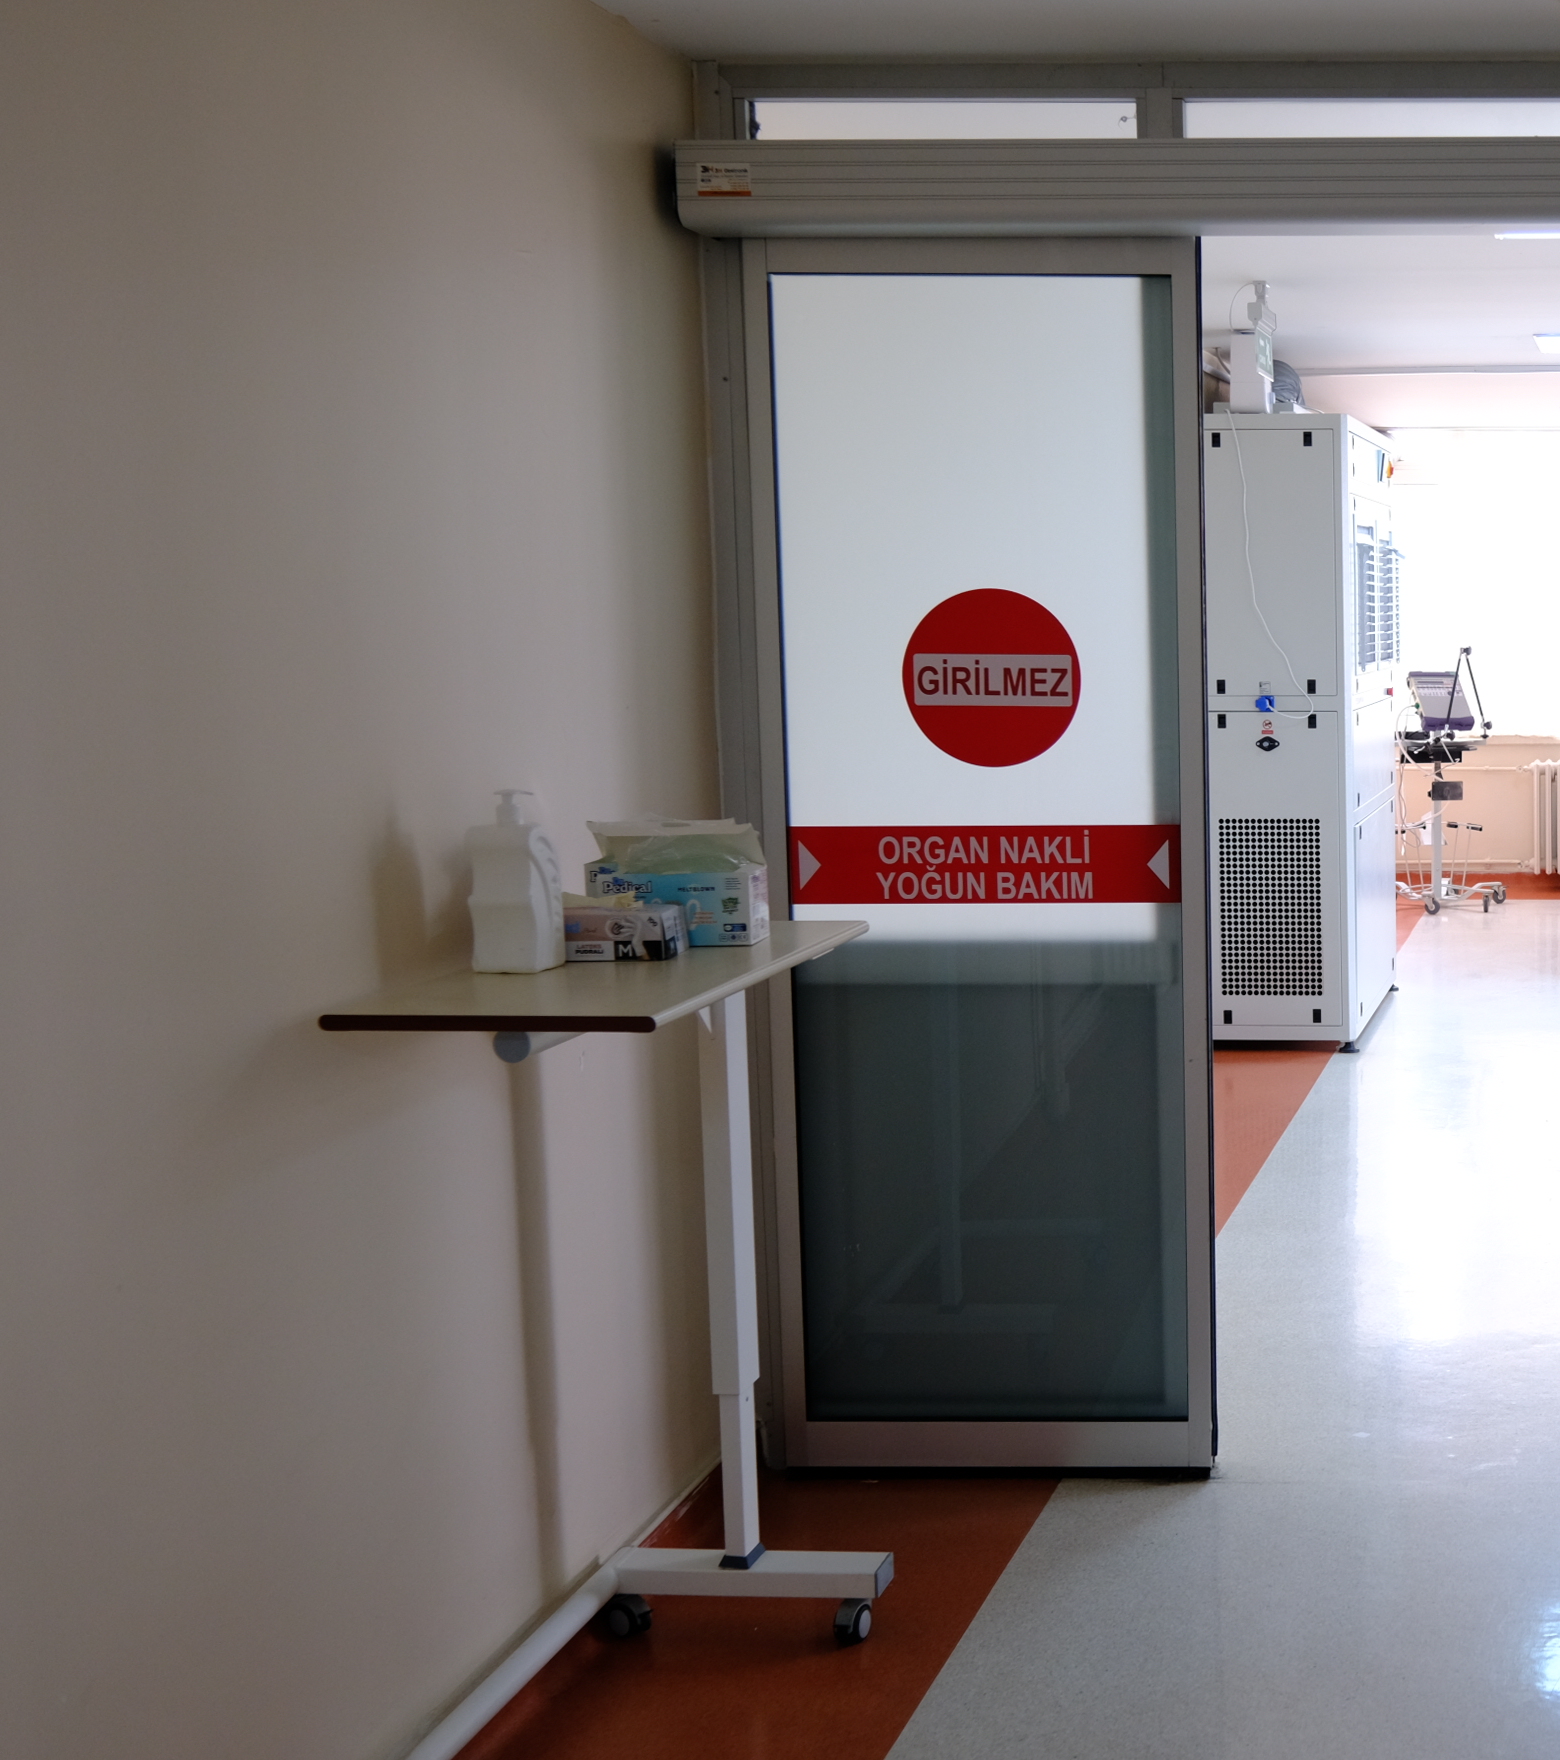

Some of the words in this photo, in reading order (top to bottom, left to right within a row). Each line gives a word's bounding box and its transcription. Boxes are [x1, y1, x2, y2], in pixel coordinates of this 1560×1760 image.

[917, 658, 1069, 697] GİRİLMEZ
[877, 836, 989, 864] ORGAN
[999, 830, 1090, 864] NAKLİ
[875, 865, 986, 900] YOĞUN
[996, 872, 1094, 900] BAKIM
[618, 944, 633, 957] M
